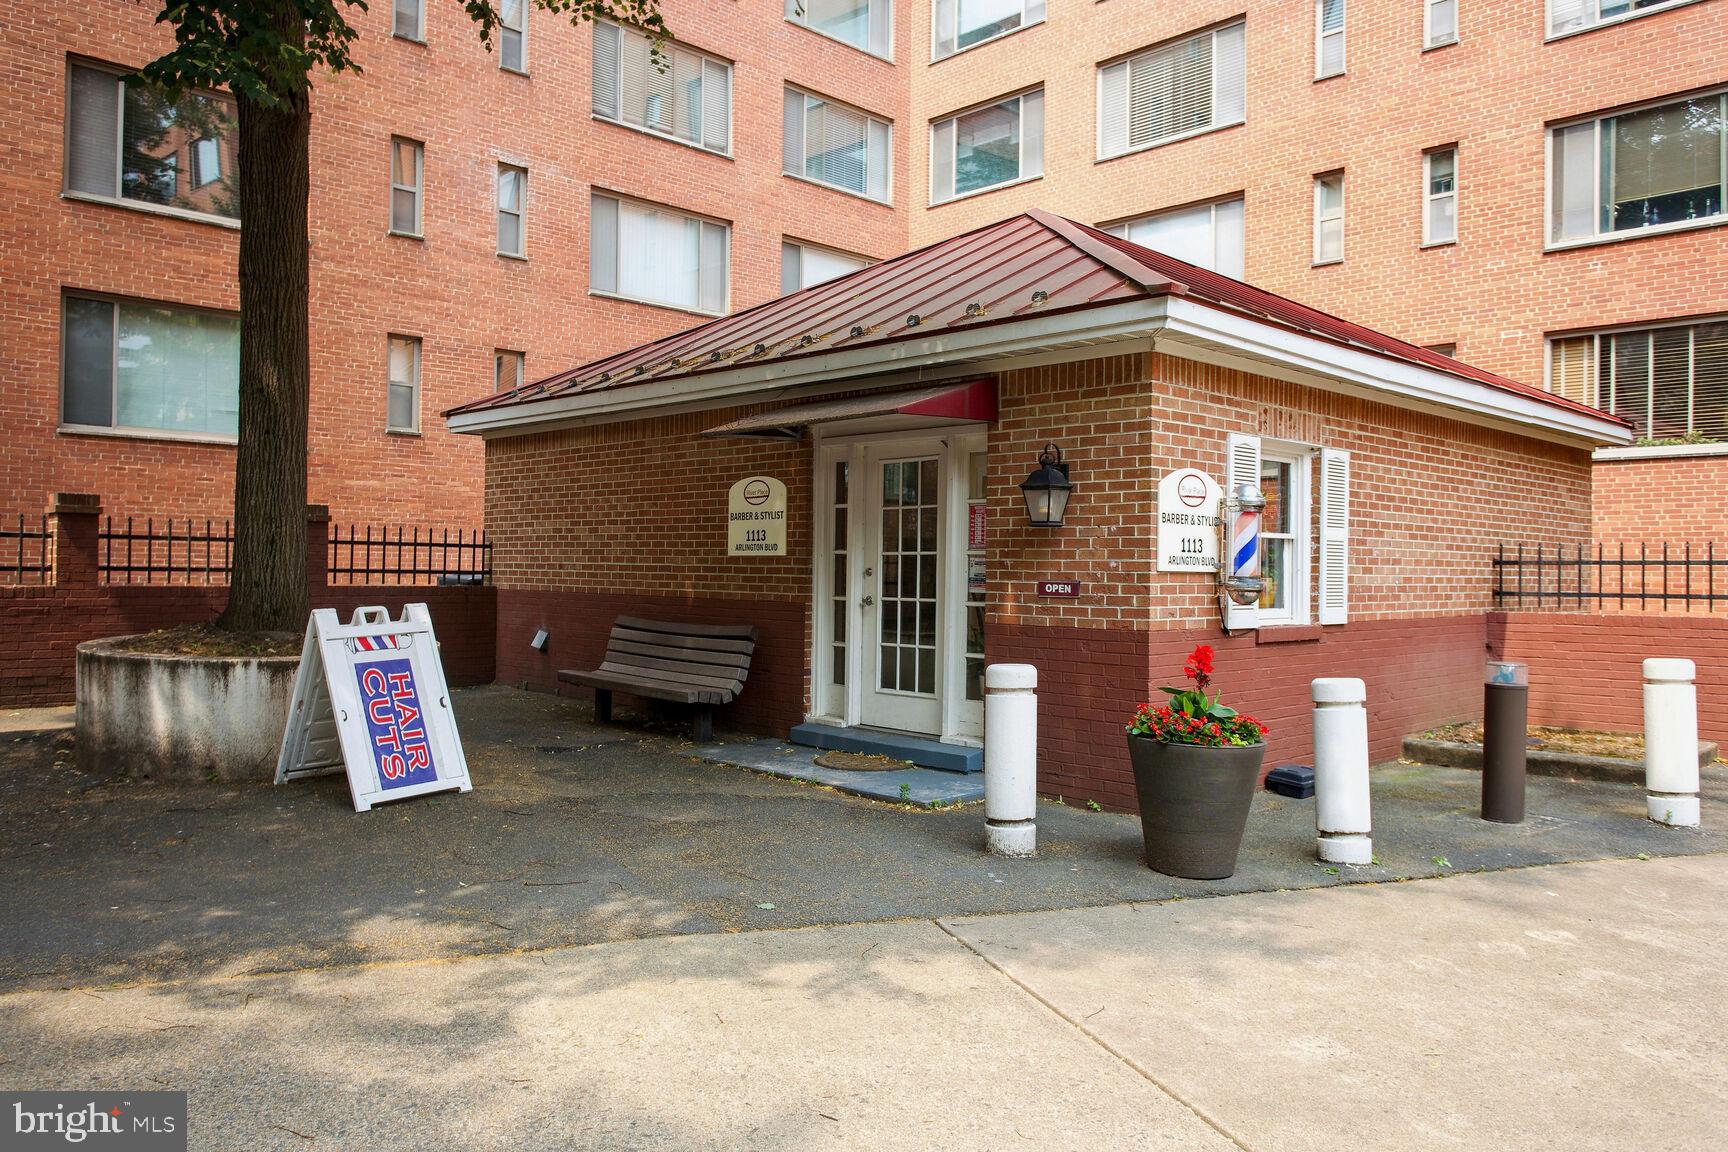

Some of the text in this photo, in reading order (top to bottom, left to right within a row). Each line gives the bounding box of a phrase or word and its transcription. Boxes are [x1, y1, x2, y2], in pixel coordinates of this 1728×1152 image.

[730, 510, 784, 521] BARBER & STYLIST
[1161, 512, 1189, 526] BARBER
[1190, 514, 1195, 526] &
[746, 529, 766, 542] 1113
[735, 543, 778, 552] ARLINGTON BLVD
[1181, 537, 1203, 553] 1113
[1168, 555, 1216, 567] ARLINGTON BLVD
[1045, 584, 1072, 593] OPEN
[362, 667, 406, 780] CUTS
[388, 672, 429, 772] HAIR
